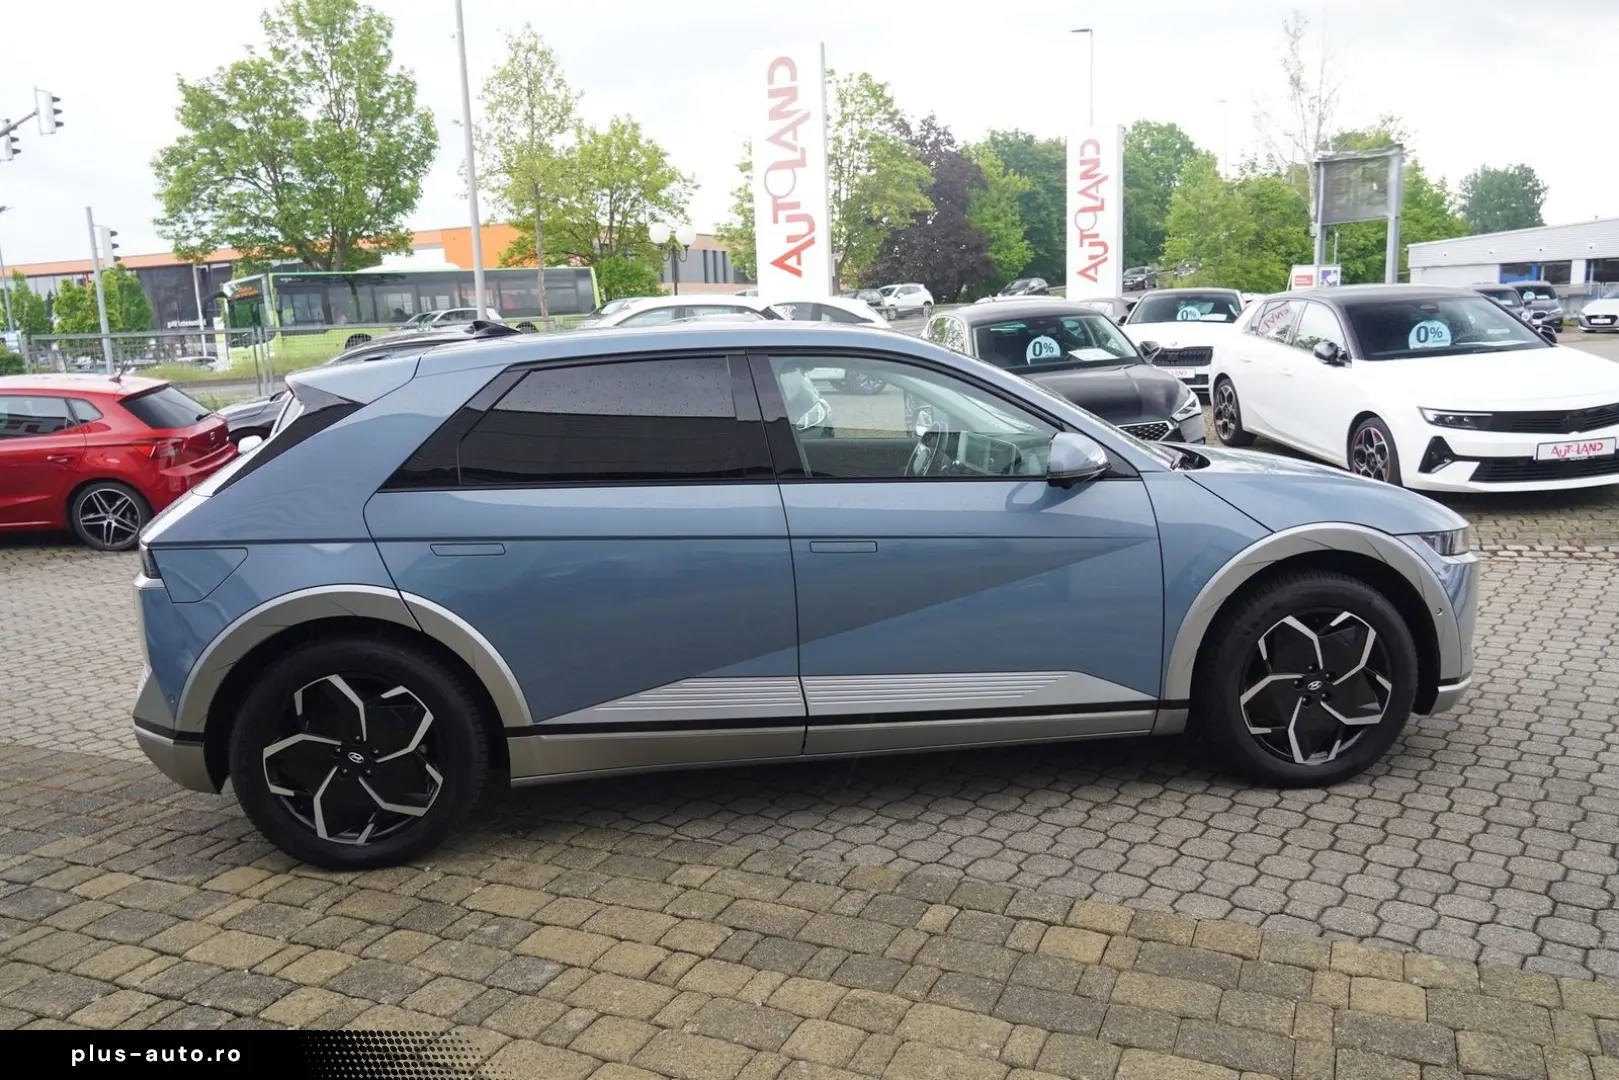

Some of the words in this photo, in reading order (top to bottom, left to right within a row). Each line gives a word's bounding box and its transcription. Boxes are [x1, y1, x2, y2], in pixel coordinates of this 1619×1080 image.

[1416, 325, 1443, 343] 0%
[1032, 341, 1055, 357] 0%
[1551, 442, 1603, 458] AUTLAND
